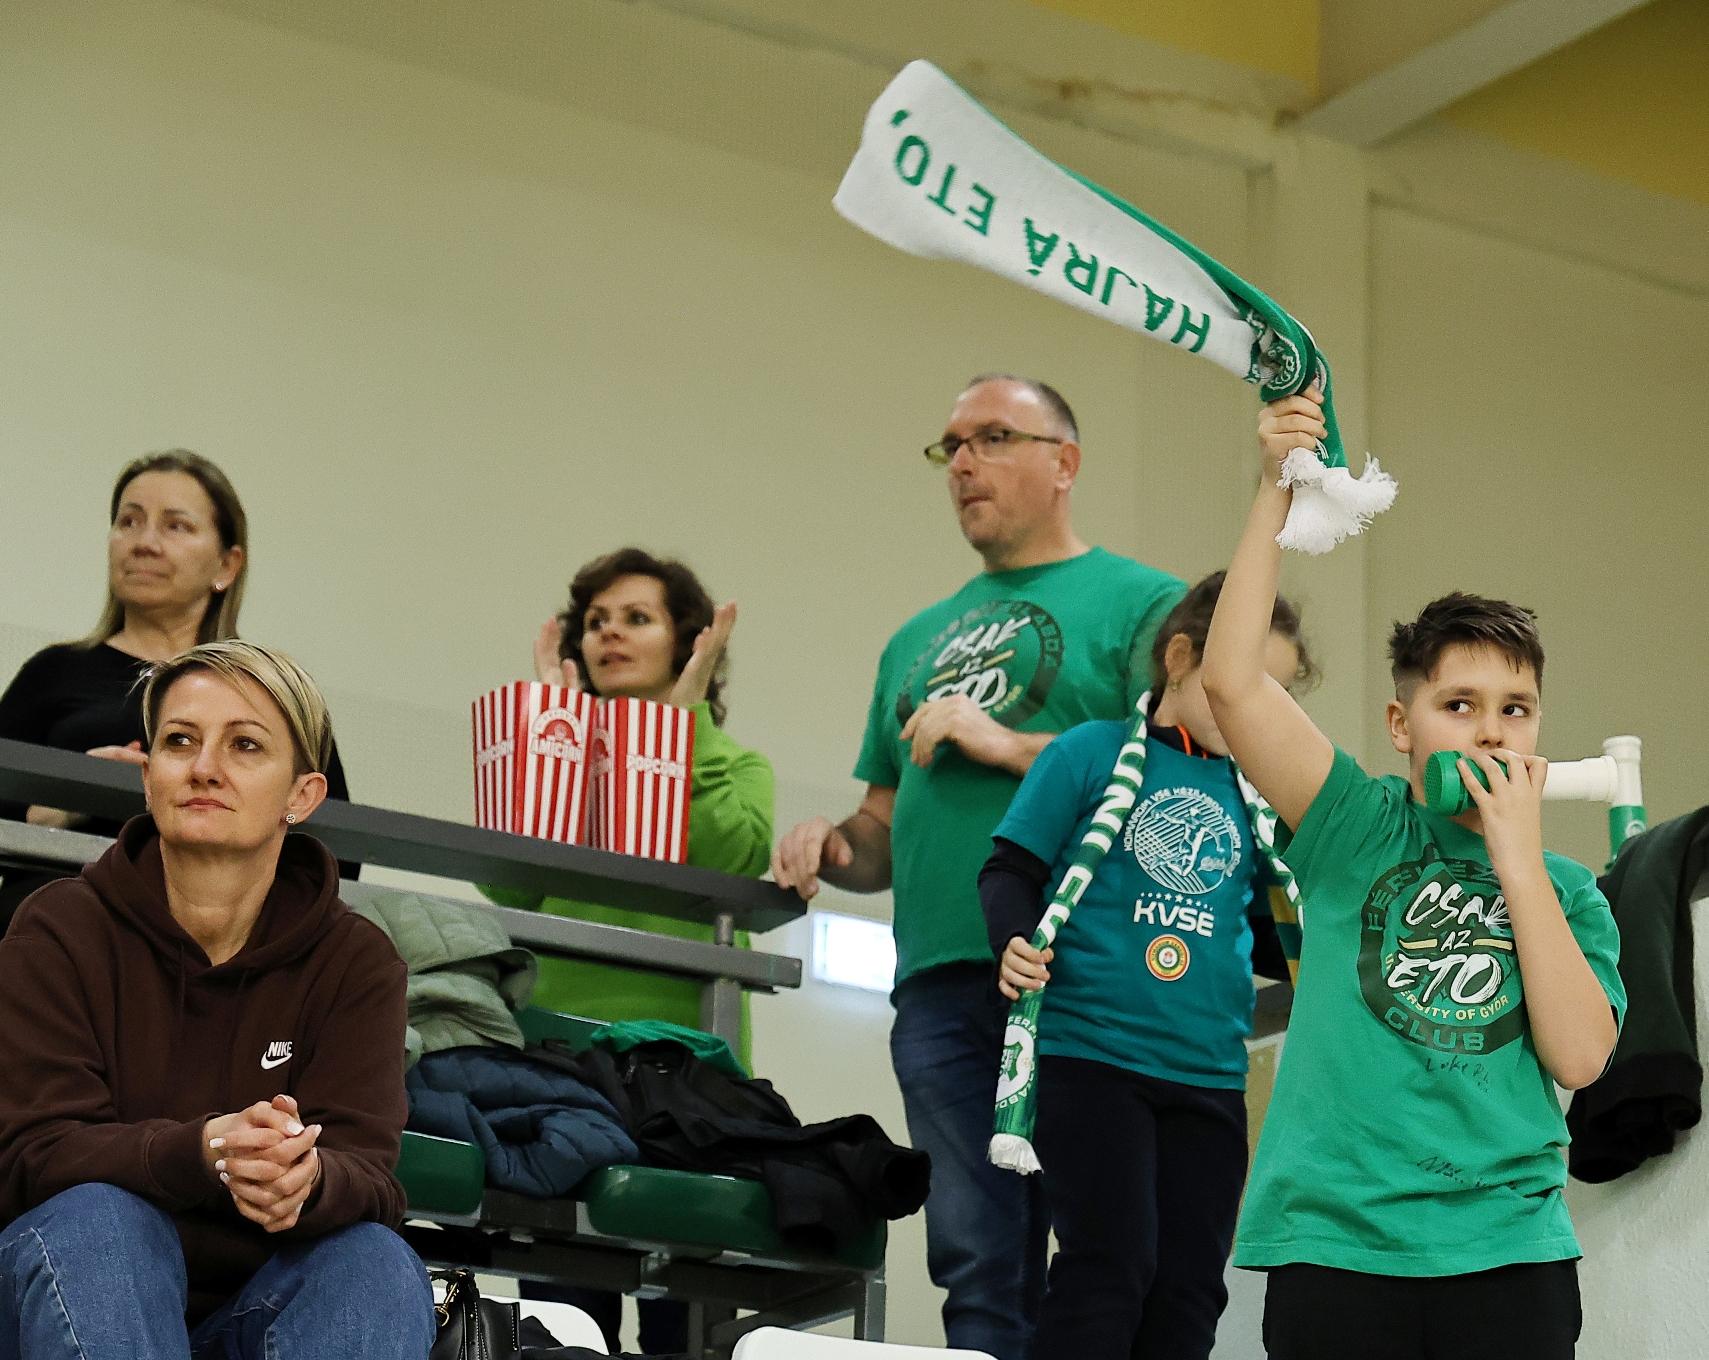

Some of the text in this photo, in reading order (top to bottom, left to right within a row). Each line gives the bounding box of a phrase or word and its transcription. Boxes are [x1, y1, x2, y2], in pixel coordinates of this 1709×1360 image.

[890, 109, 1211, 353] HAJRÁ ETO,
[626, 754, 686, 780] POPCORN
[1133, 899, 1215, 938] KVSE
[1440, 929, 1471, 952] AZ
[1387, 953, 1503, 1004] ETO
[1455, 1008, 1475, 1021] OF
[1479, 994, 1509, 1019] GYŐR
[1384, 1006, 1485, 1051] CLUB
[267, 1041, 293, 1058] NIKE
